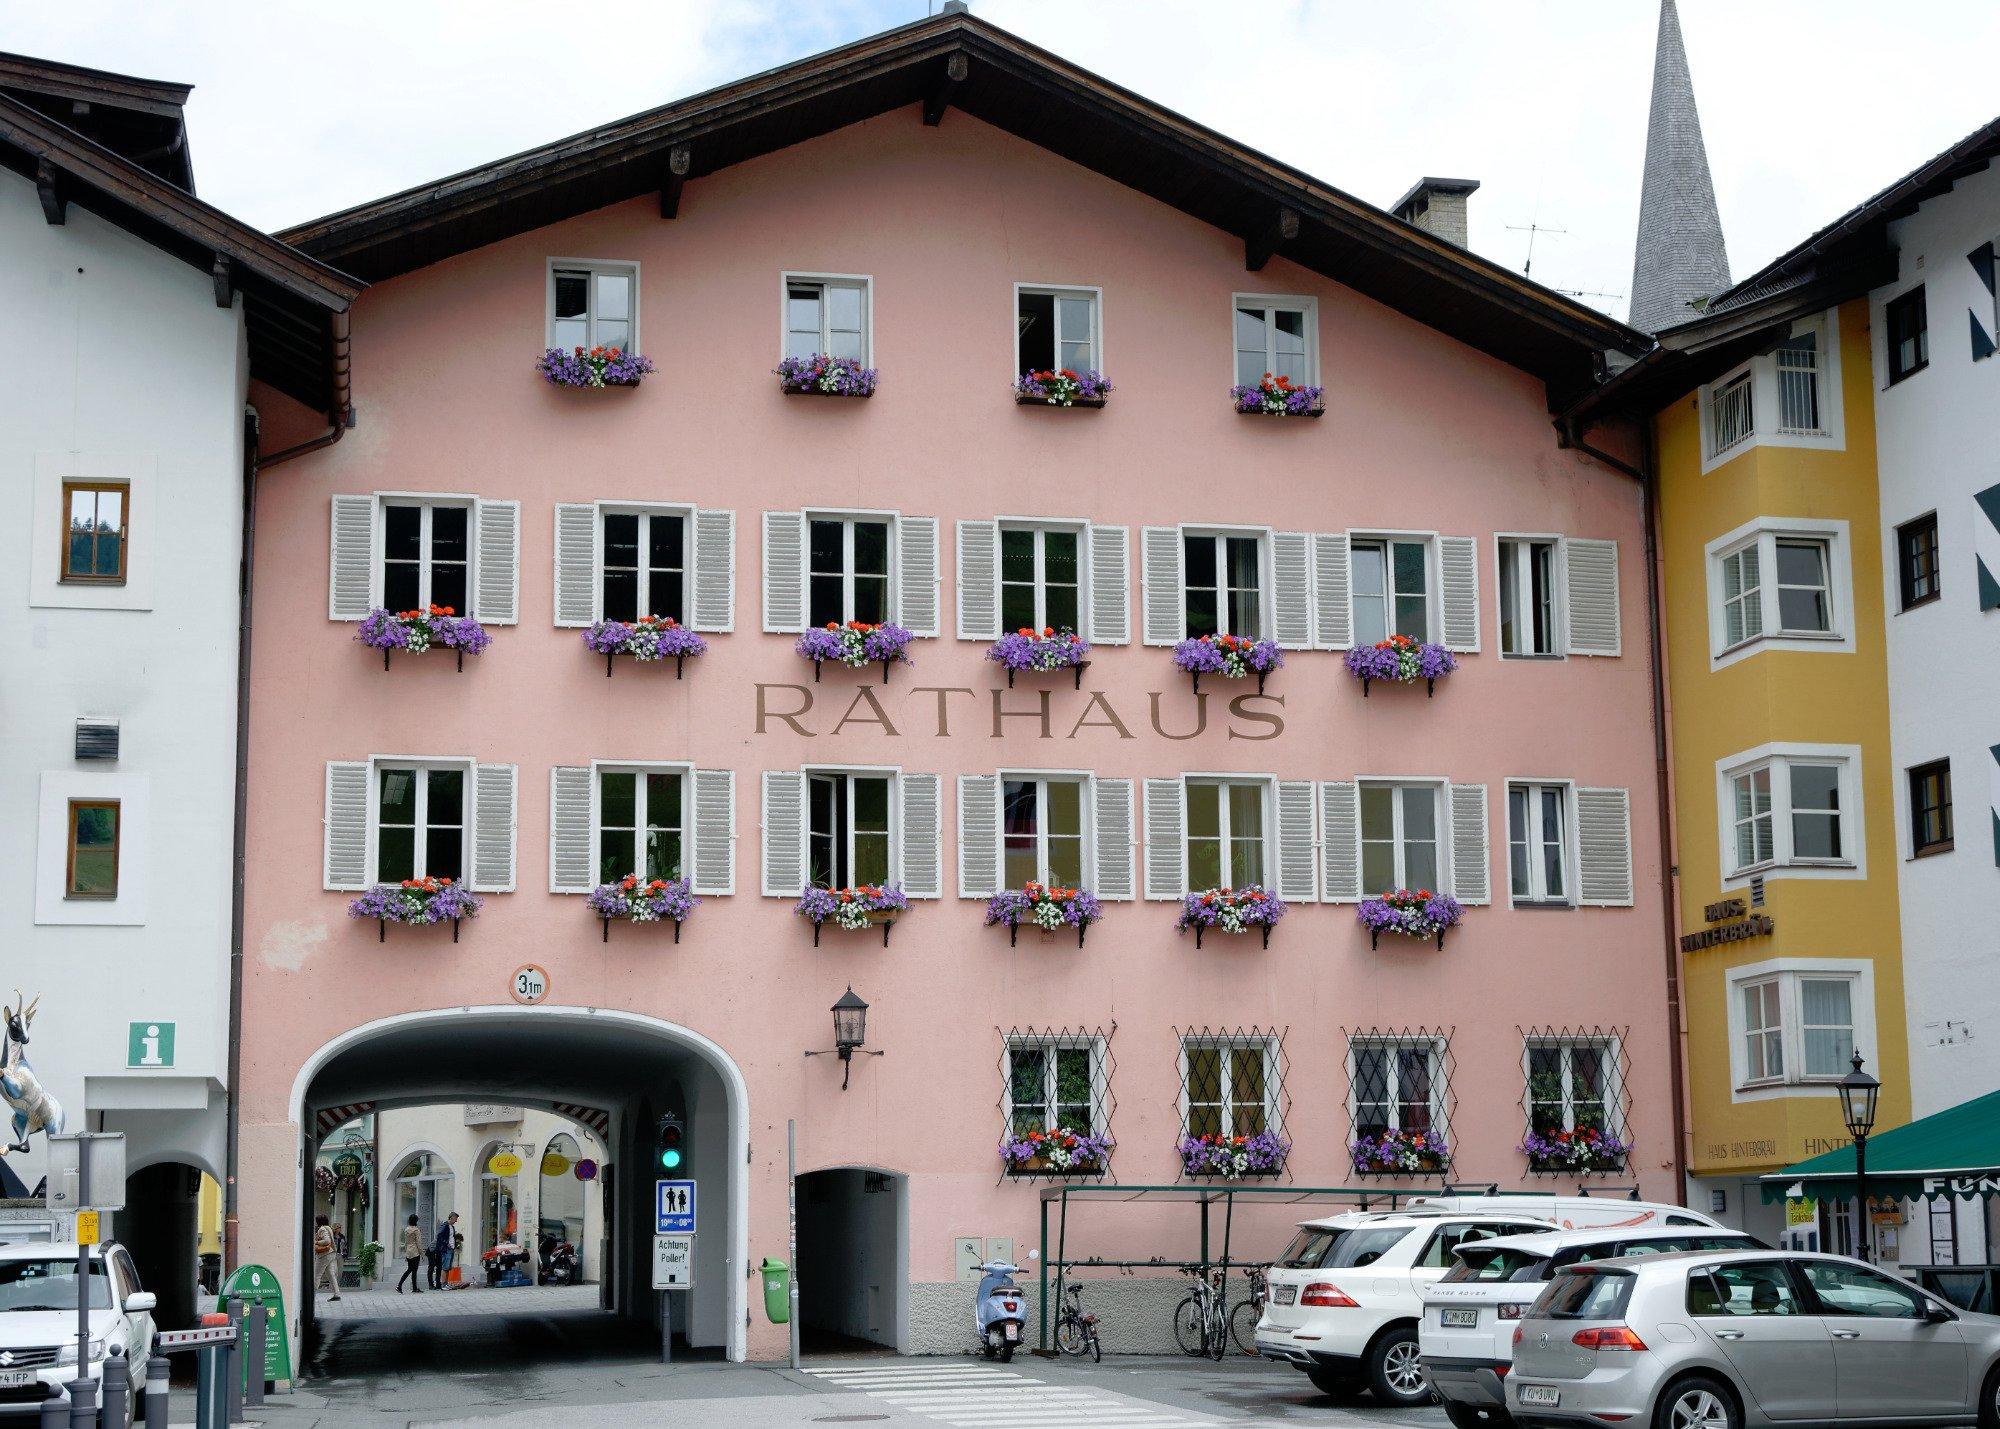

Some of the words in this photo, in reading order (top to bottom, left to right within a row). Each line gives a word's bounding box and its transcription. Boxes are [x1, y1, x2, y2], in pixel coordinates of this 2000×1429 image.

[753, 683, 1286, 741] RATHAUS
[1704, 898, 1746, 922] HAUS
[1708, 1144, 1728, 1160] HAUS
[1731, 1138, 1776, 1159] HINTERBRÄU
[658, 1240, 689, 1252] Achtung
[661, 1253, 686, 1263] Poller!
